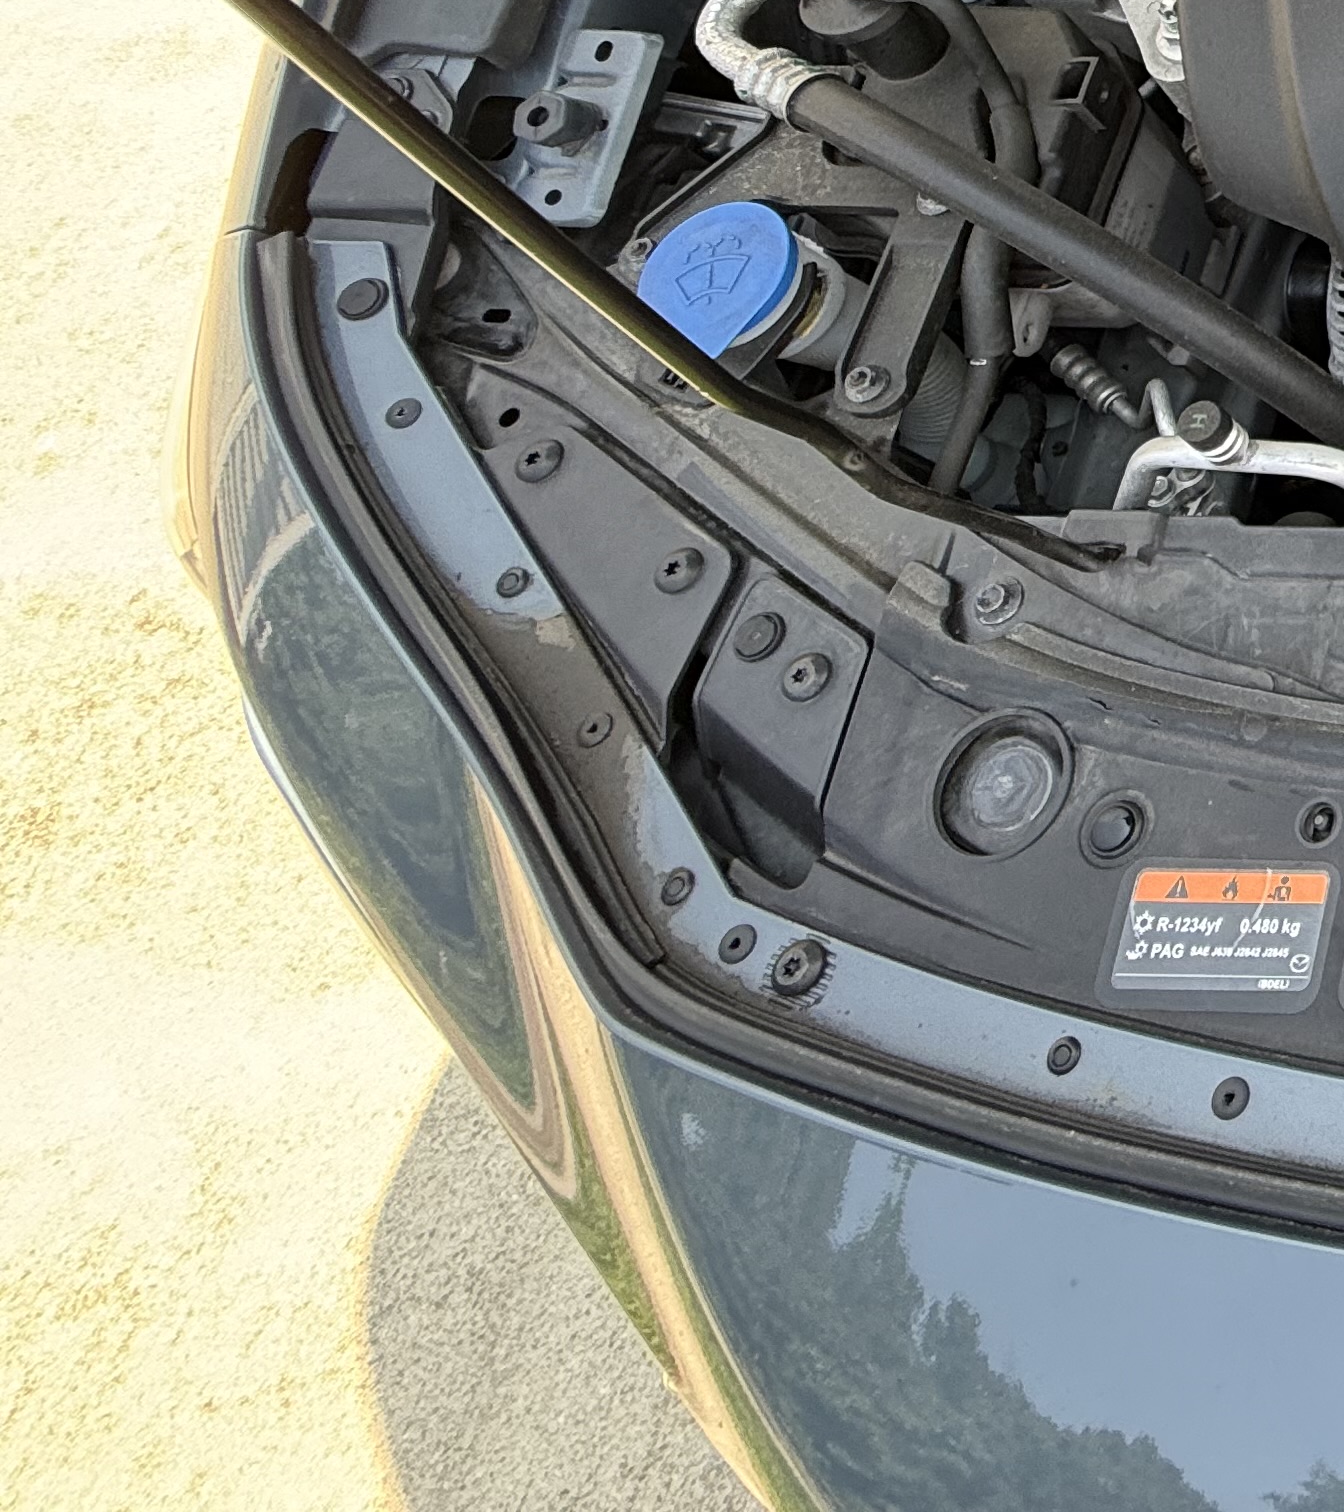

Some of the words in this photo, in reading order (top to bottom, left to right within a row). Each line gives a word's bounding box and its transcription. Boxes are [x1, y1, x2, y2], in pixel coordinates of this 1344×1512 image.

[1156, 916, 1224, 936] R-1234yf
[1239, 917, 1279, 934] 0.480
[1280, 917, 1301, 938] kg
[1150, 943, 1185, 959] PAG
[1190, 946, 1211, 957] SAE
